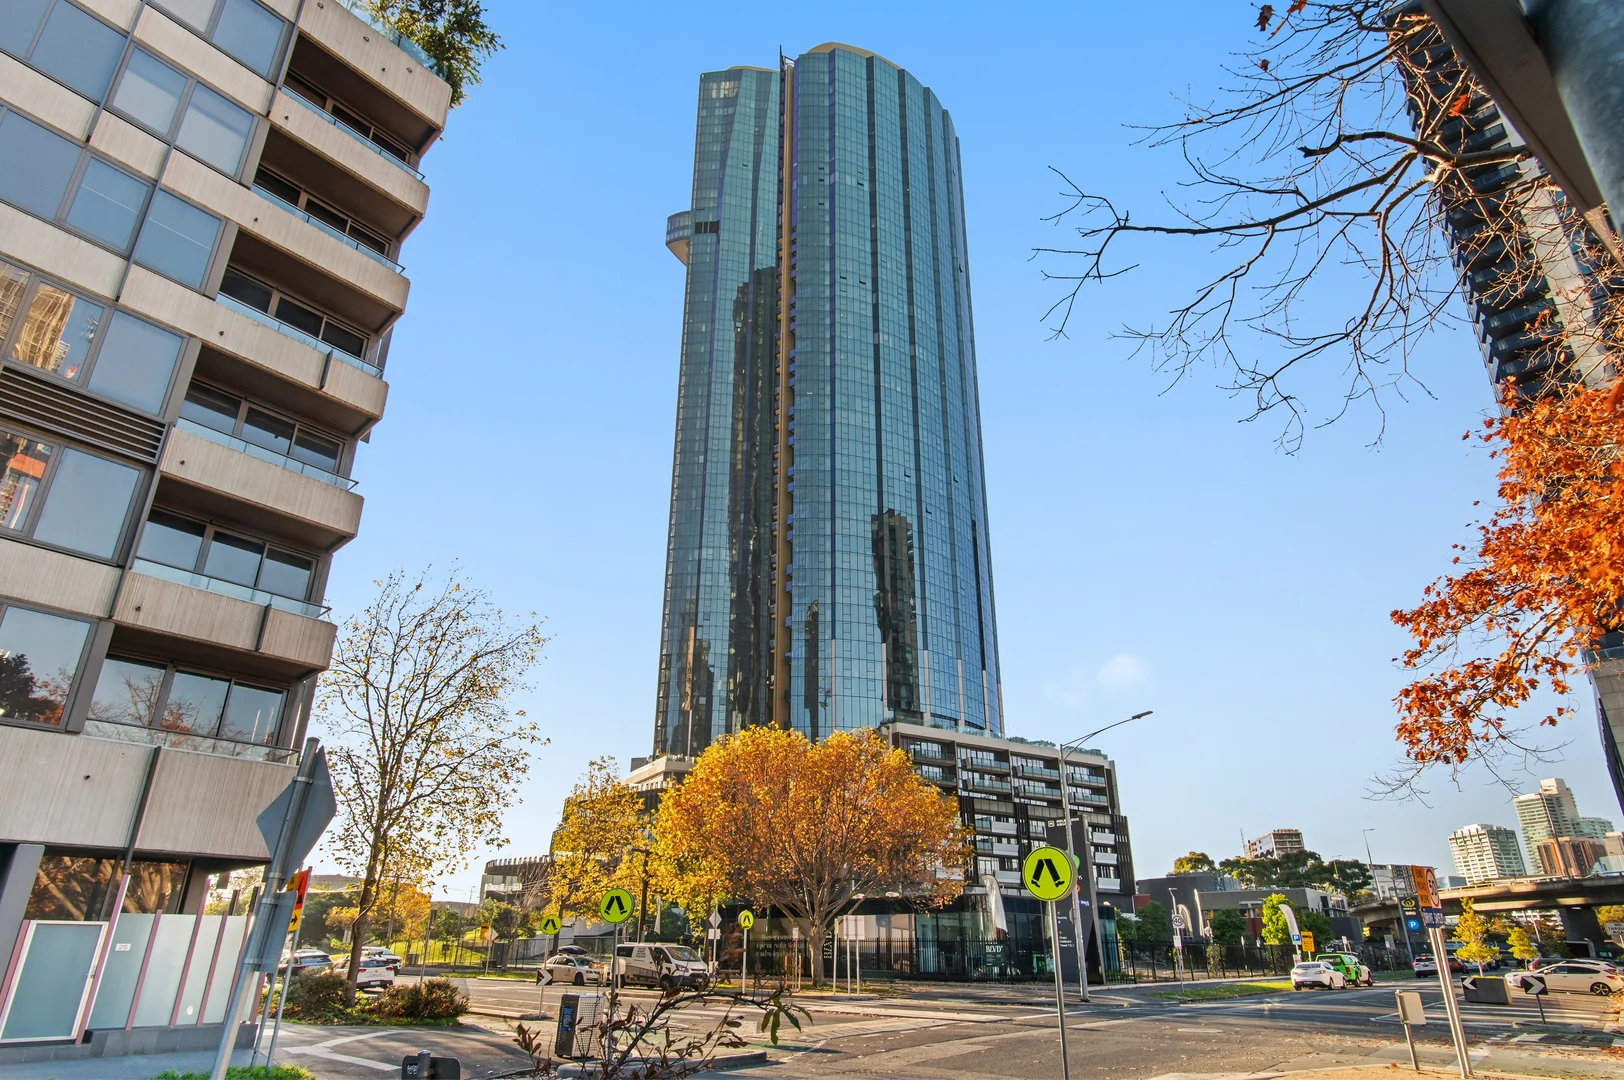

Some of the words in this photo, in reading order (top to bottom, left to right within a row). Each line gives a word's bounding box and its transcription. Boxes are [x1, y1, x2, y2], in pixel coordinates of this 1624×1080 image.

[1415, 869, 1424, 878] END
[1416, 881, 1427, 891] ROAD
[1428, 879, 1438, 896] 50
